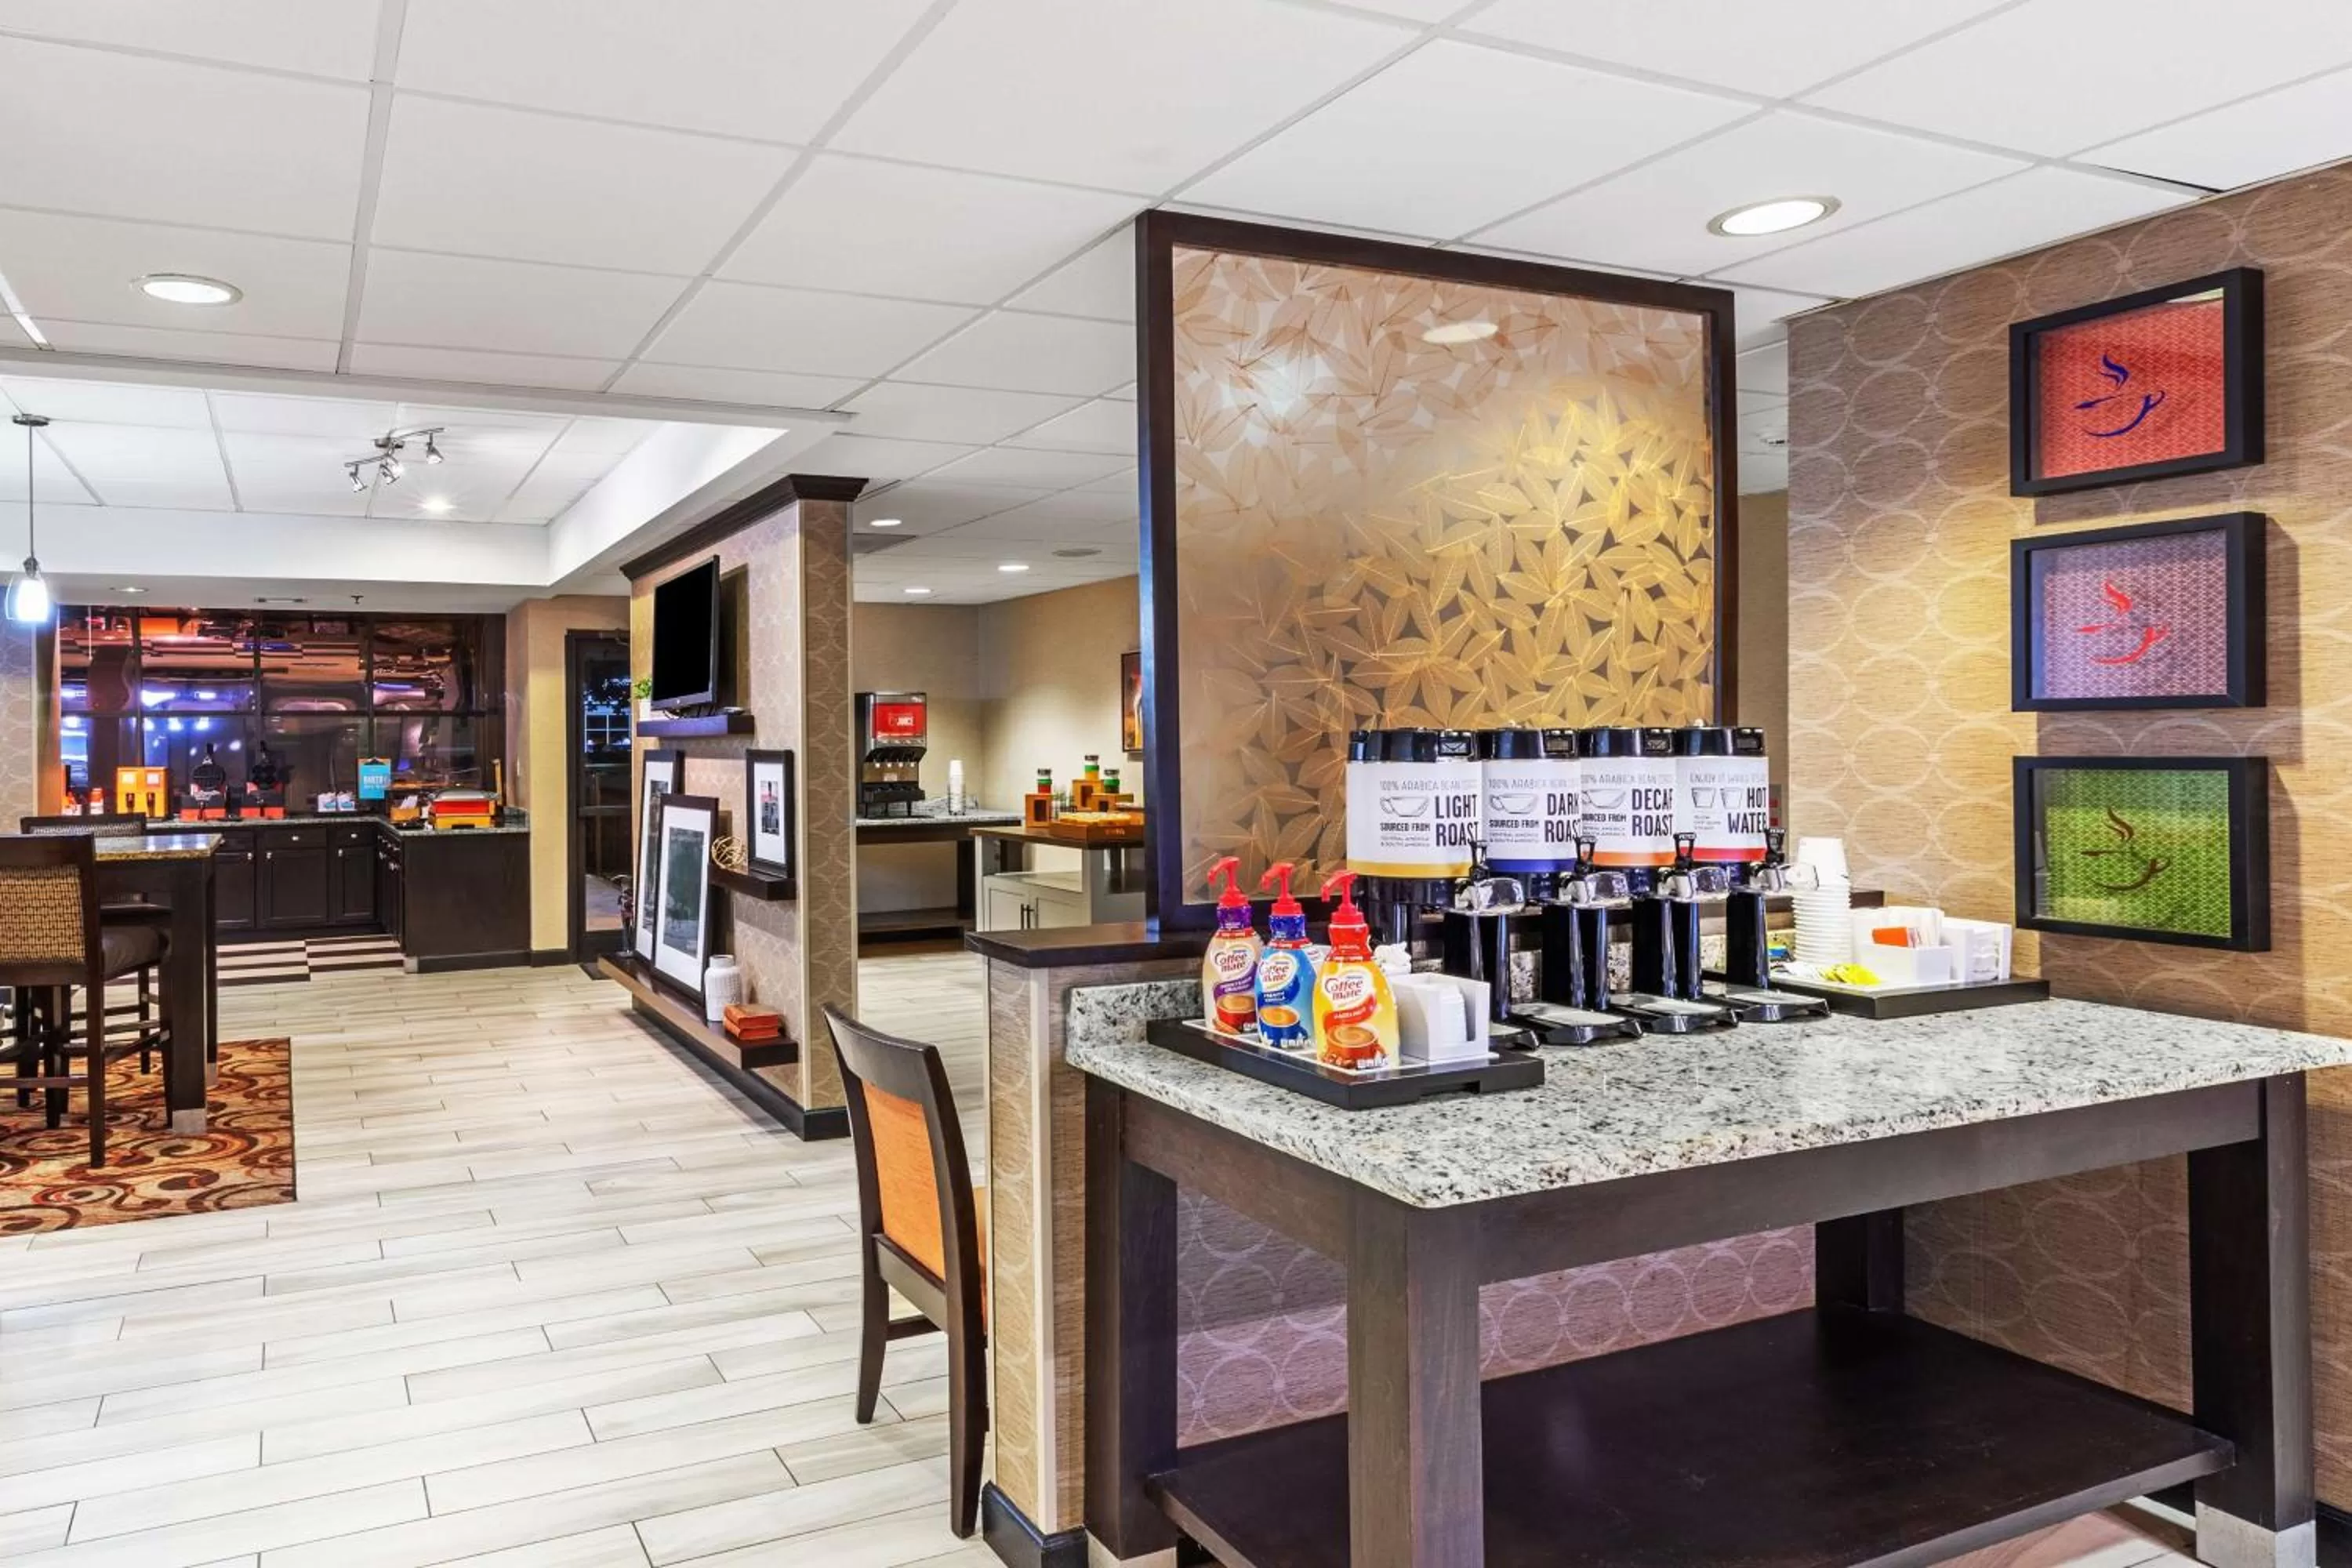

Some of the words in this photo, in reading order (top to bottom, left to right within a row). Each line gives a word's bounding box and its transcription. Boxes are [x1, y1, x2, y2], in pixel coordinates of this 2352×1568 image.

[1435, 794, 1477, 819] LIGHT
[1547, 793, 1579, 816] DARK
[1632, 788, 1673, 811] DECAF
[1747, 787, 1766, 808] HOT
[1380, 822, 1409, 832] SOURCED
[1411, 822, 1431, 832] FROM
[1489, 819, 1519, 829] SOURCED
[1521, 819, 1539, 829] FROM
[1582, 813, 1606, 822] OURCED
[1608, 813, 1626, 822] FROM
[1632, 814, 1673, 837] ROAST
[1436, 821, 1479, 847] ROAST
[1215, 952, 1248, 967] Coffee
[1324, 978, 1364, 994] Coffee
